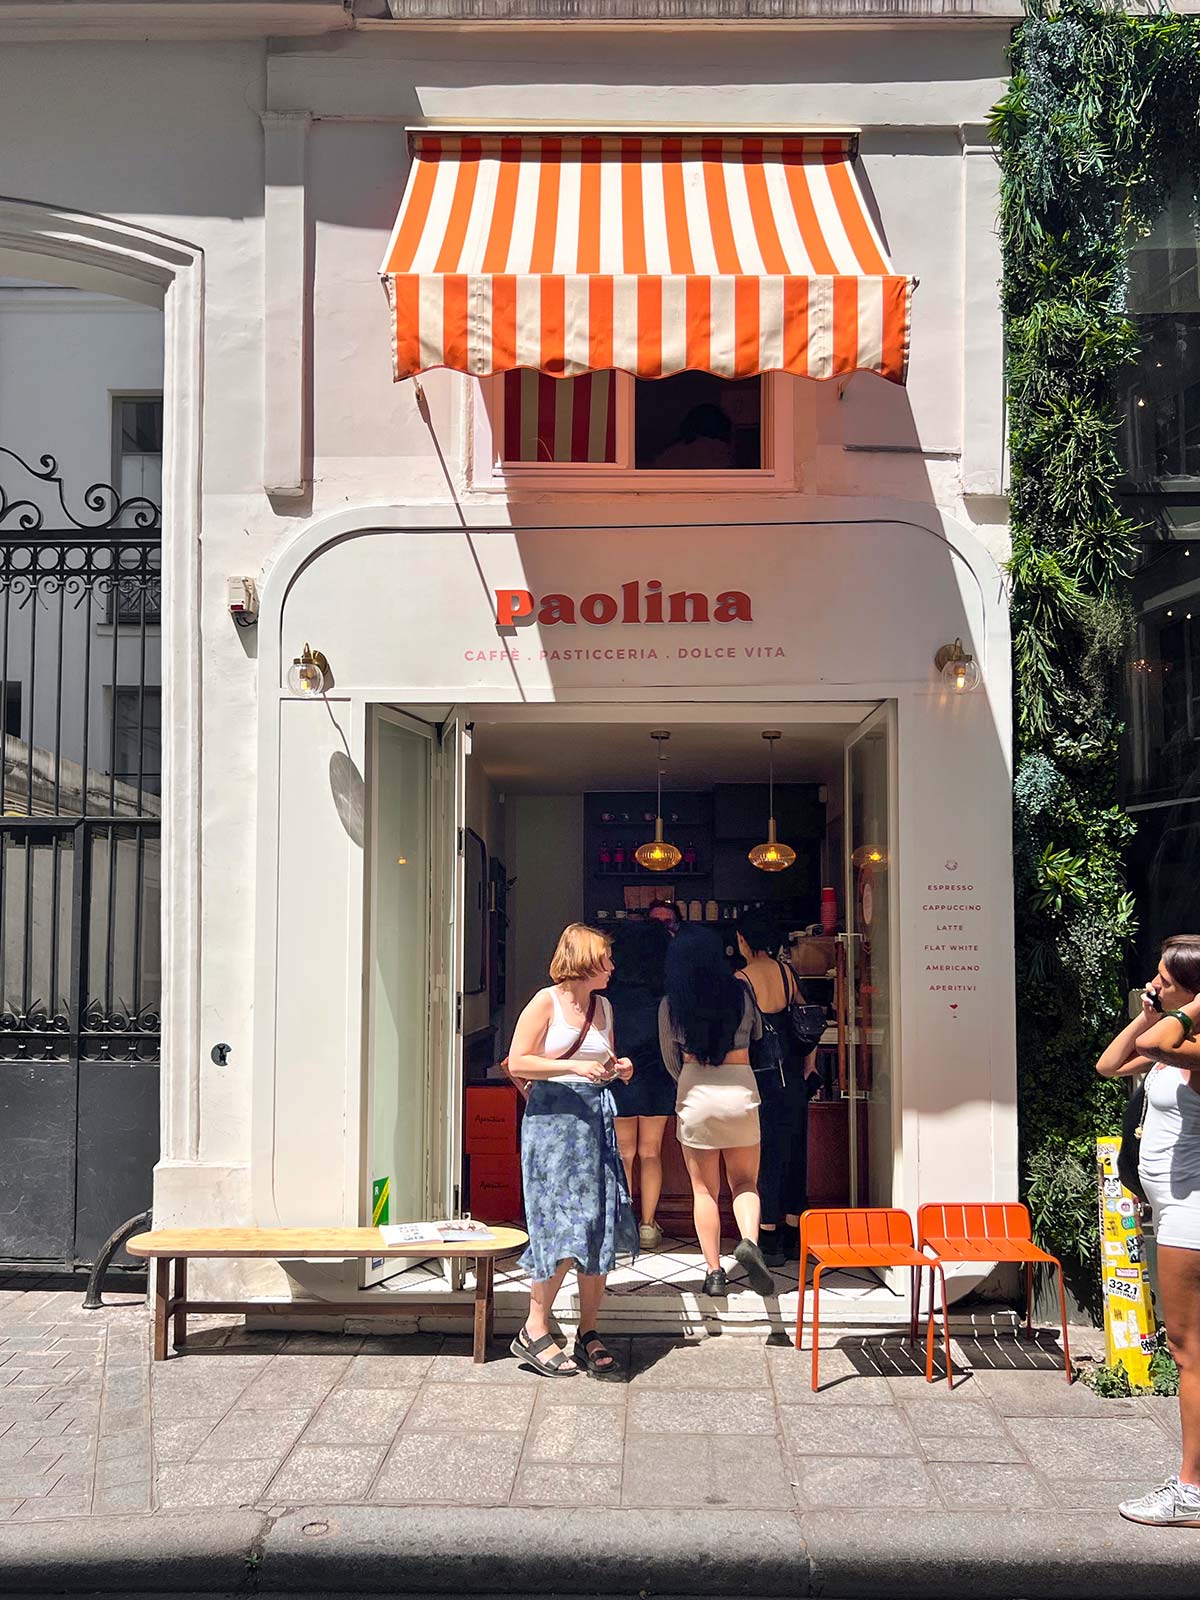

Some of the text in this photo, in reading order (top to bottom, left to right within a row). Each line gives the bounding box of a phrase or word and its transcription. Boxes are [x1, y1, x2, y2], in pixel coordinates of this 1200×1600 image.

[464, 647, 520, 662] CAFFÈ
[539, 648, 658, 661] PASTICCERIA
[678, 647, 736, 660] DOLCE
[745, 646, 786, 659] VITA
[1108, 1278, 1138, 1296] 322.1
